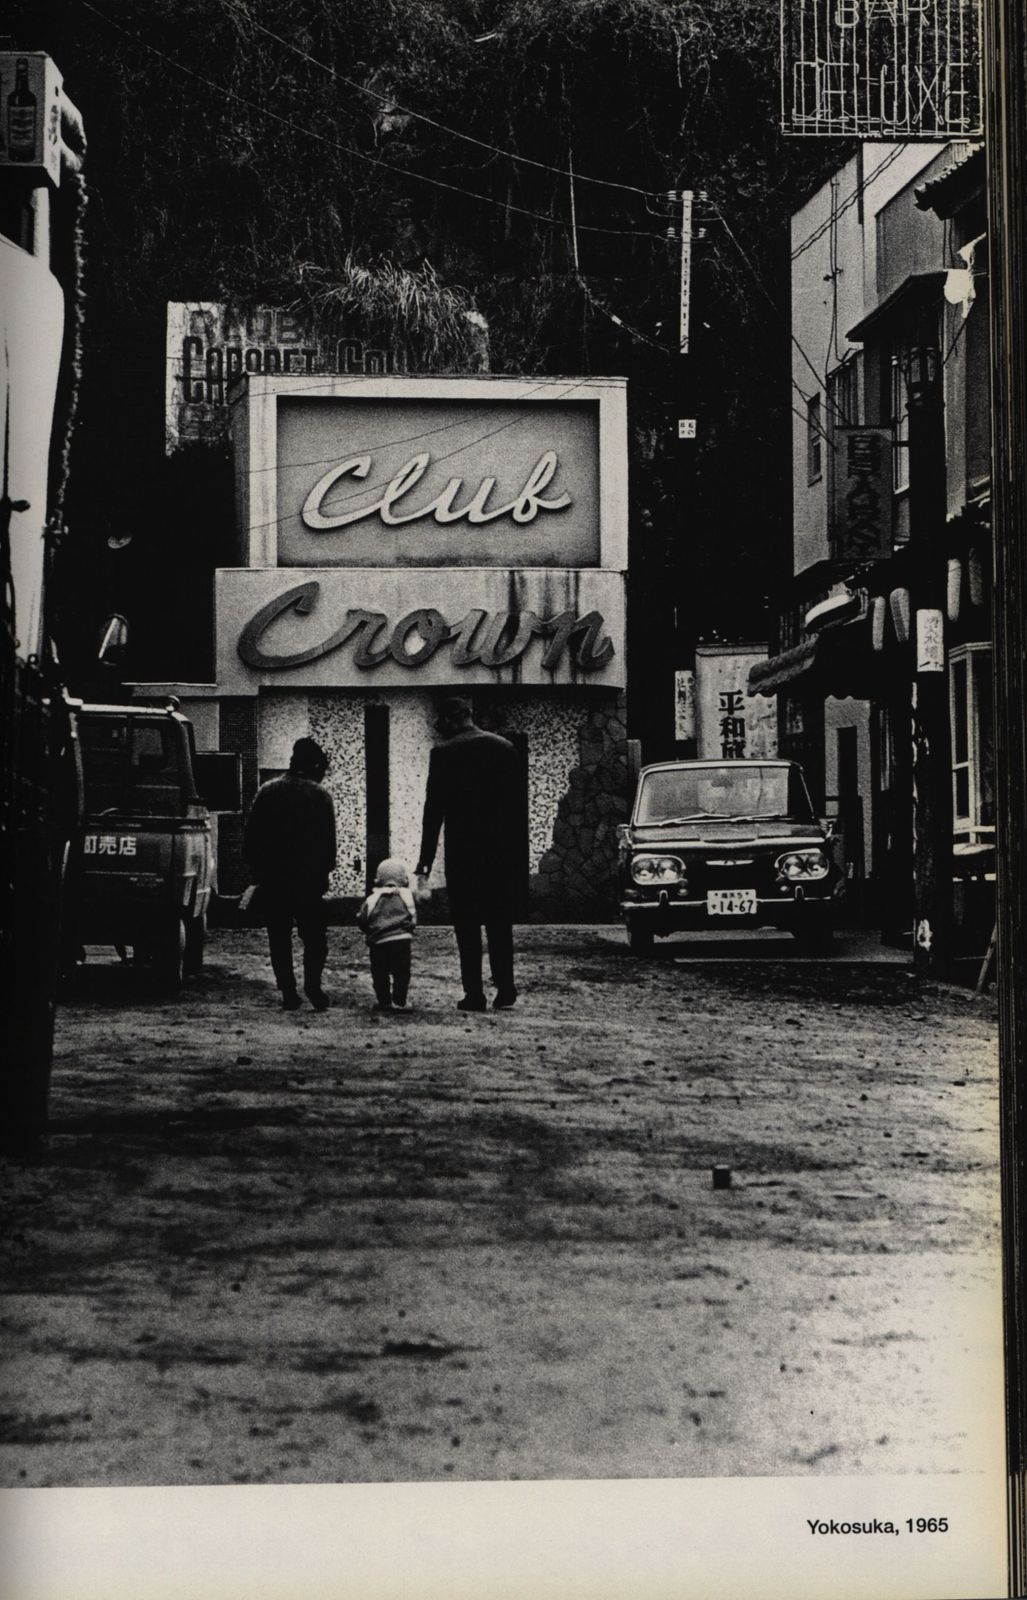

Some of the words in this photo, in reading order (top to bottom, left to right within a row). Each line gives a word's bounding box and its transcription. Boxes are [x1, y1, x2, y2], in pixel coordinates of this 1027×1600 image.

[834, 0, 931, 27] BAR
[792, 61, 971, 126] DELUXE
[303, 450, 572, 530] Club
[237, 580, 616, 671] Crown
[720, 900, 754, 913] 14-67
